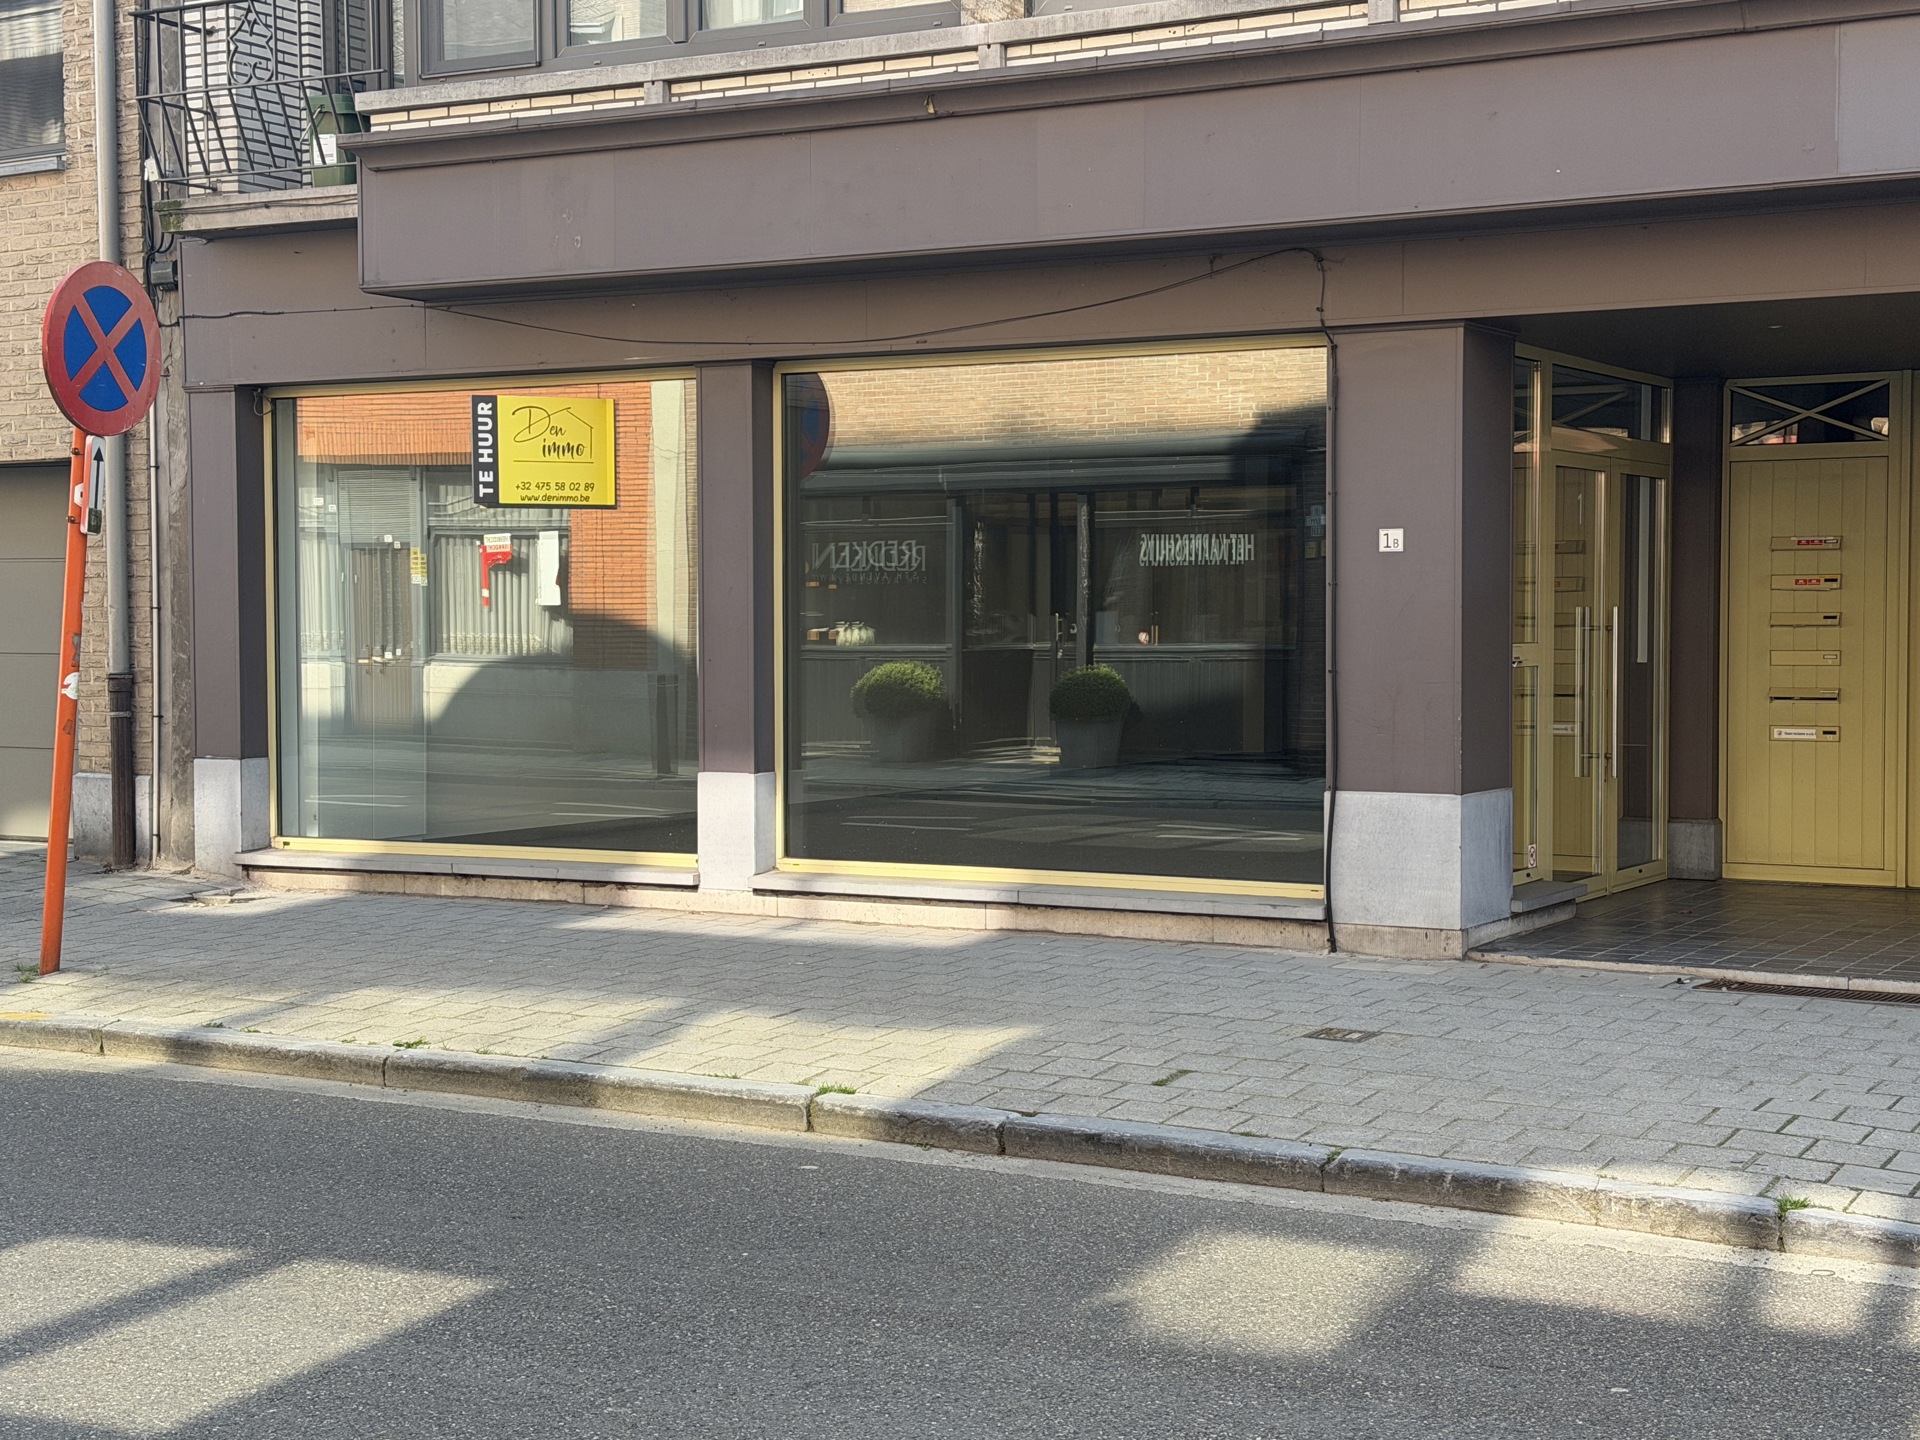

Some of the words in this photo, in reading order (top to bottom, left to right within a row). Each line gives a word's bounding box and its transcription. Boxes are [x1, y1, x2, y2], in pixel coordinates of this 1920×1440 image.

[477, 402, 494, 463] HUUR
[511, 405, 567, 443] Den
[542, 438, 587, 460] immo
[478, 470, 495, 497] TE
[515, 481, 532, 491] +32
[534, 481, 552, 491] 475
[554, 481, 566, 491] 58
[568, 481, 581, 492] 02
[583, 482, 595, 492] 89
[520, 493, 590, 502] www.denimmo.be
